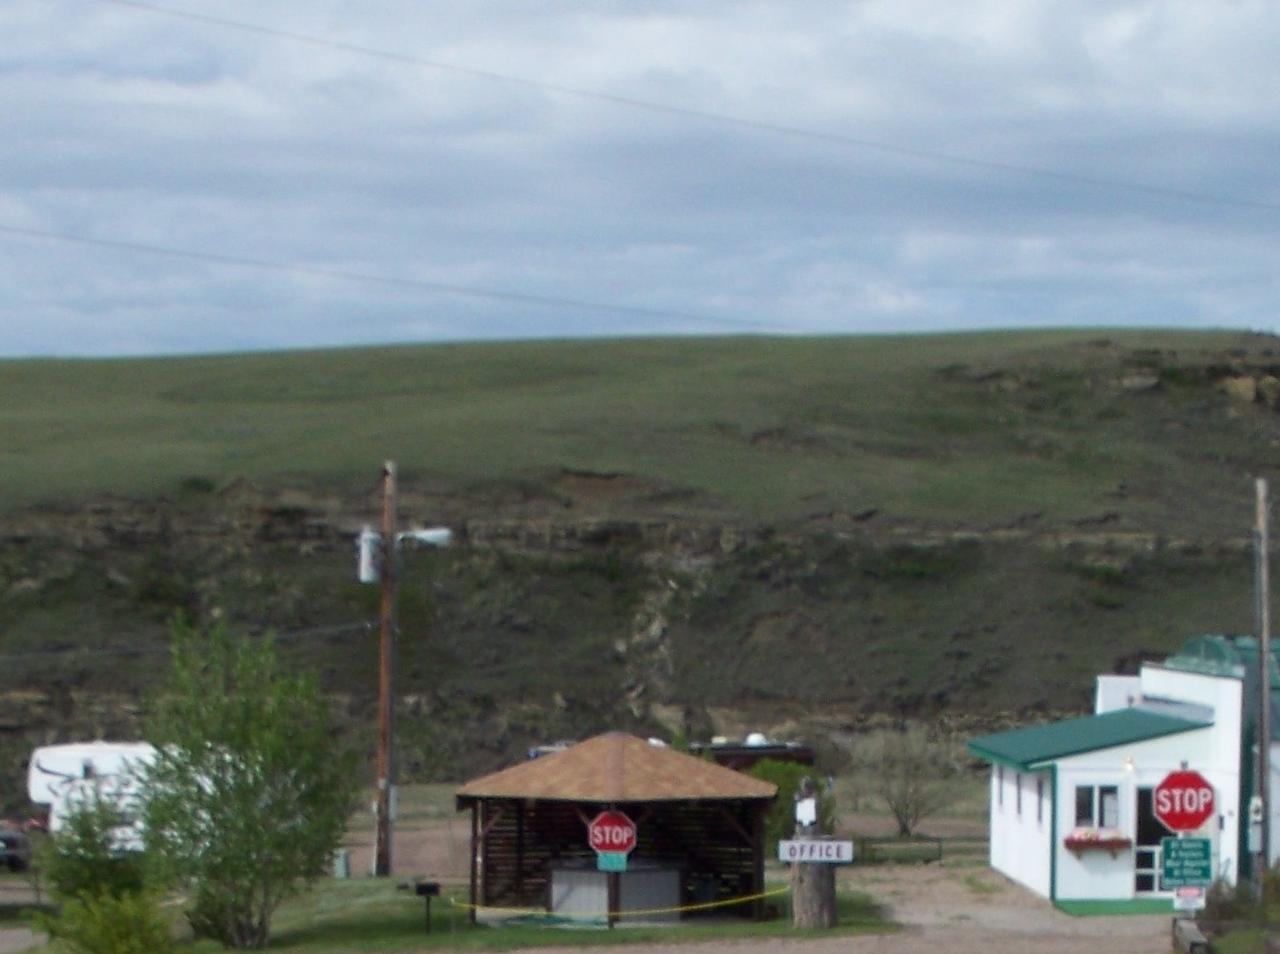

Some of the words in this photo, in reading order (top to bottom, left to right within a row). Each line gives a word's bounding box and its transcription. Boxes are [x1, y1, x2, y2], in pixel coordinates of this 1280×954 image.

[1158, 788, 1213, 813] STOP
[592, 826, 633, 844] STOP
[788, 845, 843, 860] OFFICE
